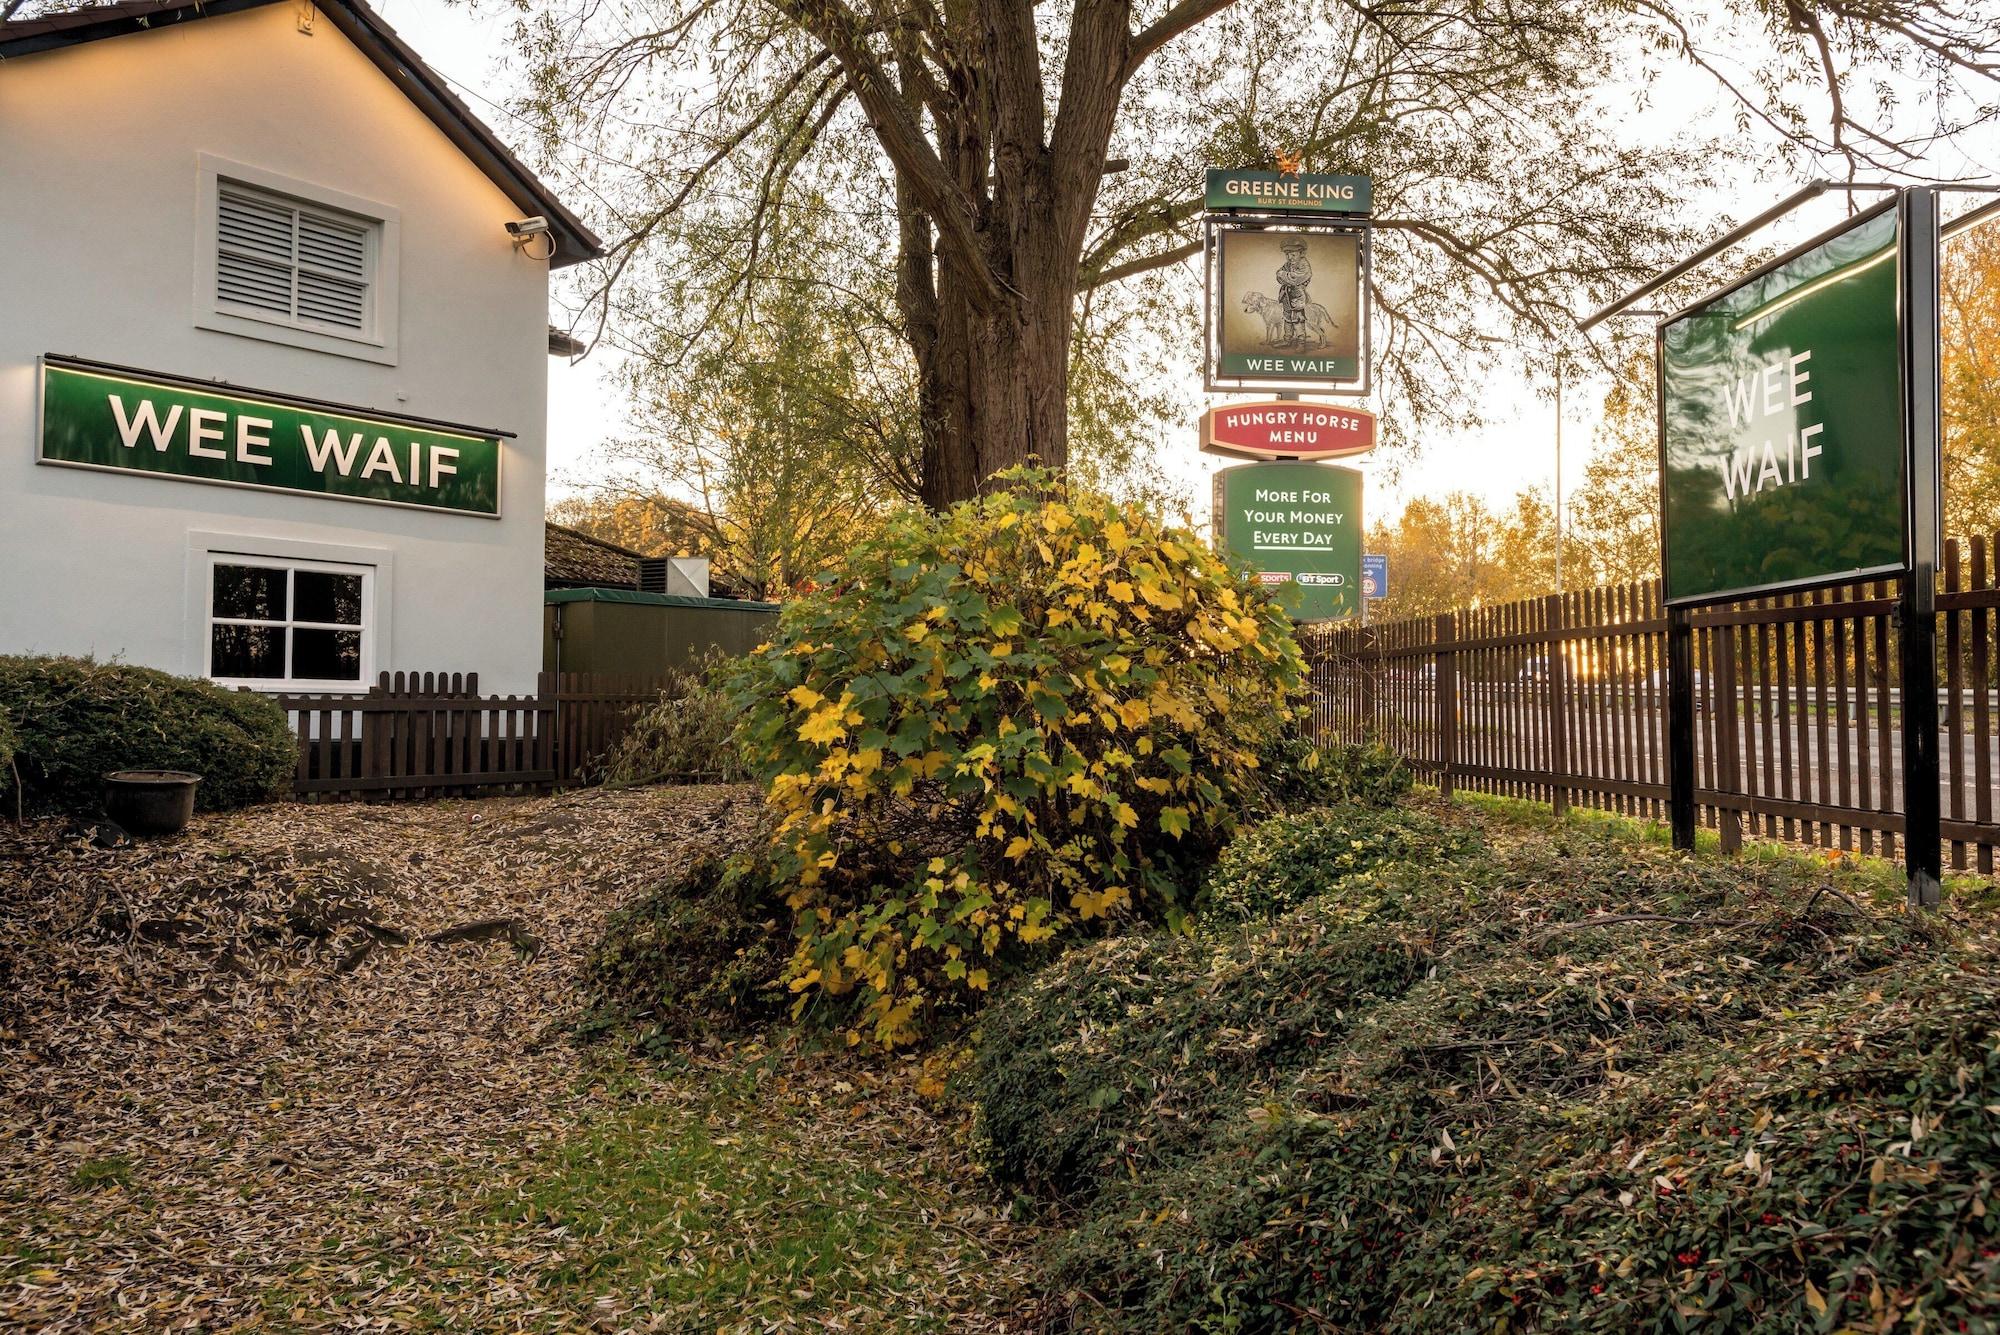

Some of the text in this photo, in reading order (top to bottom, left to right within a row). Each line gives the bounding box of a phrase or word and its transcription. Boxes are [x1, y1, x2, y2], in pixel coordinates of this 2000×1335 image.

[1225, 180, 1354, 199] GREENE KING
[1246, 358, 1335, 373] WEE WAIF
[1723, 350, 1813, 428] WEE
[1227, 411, 1360, 431] HUNGRY HORSE
[108, 394, 460, 488] WEE WAIF
[1269, 431, 1318, 443] MENU
[1719, 422, 1824, 500] WAIF
[1261, 574, 1289, 583] sports
[1316, 575, 1339, 585] Sport
